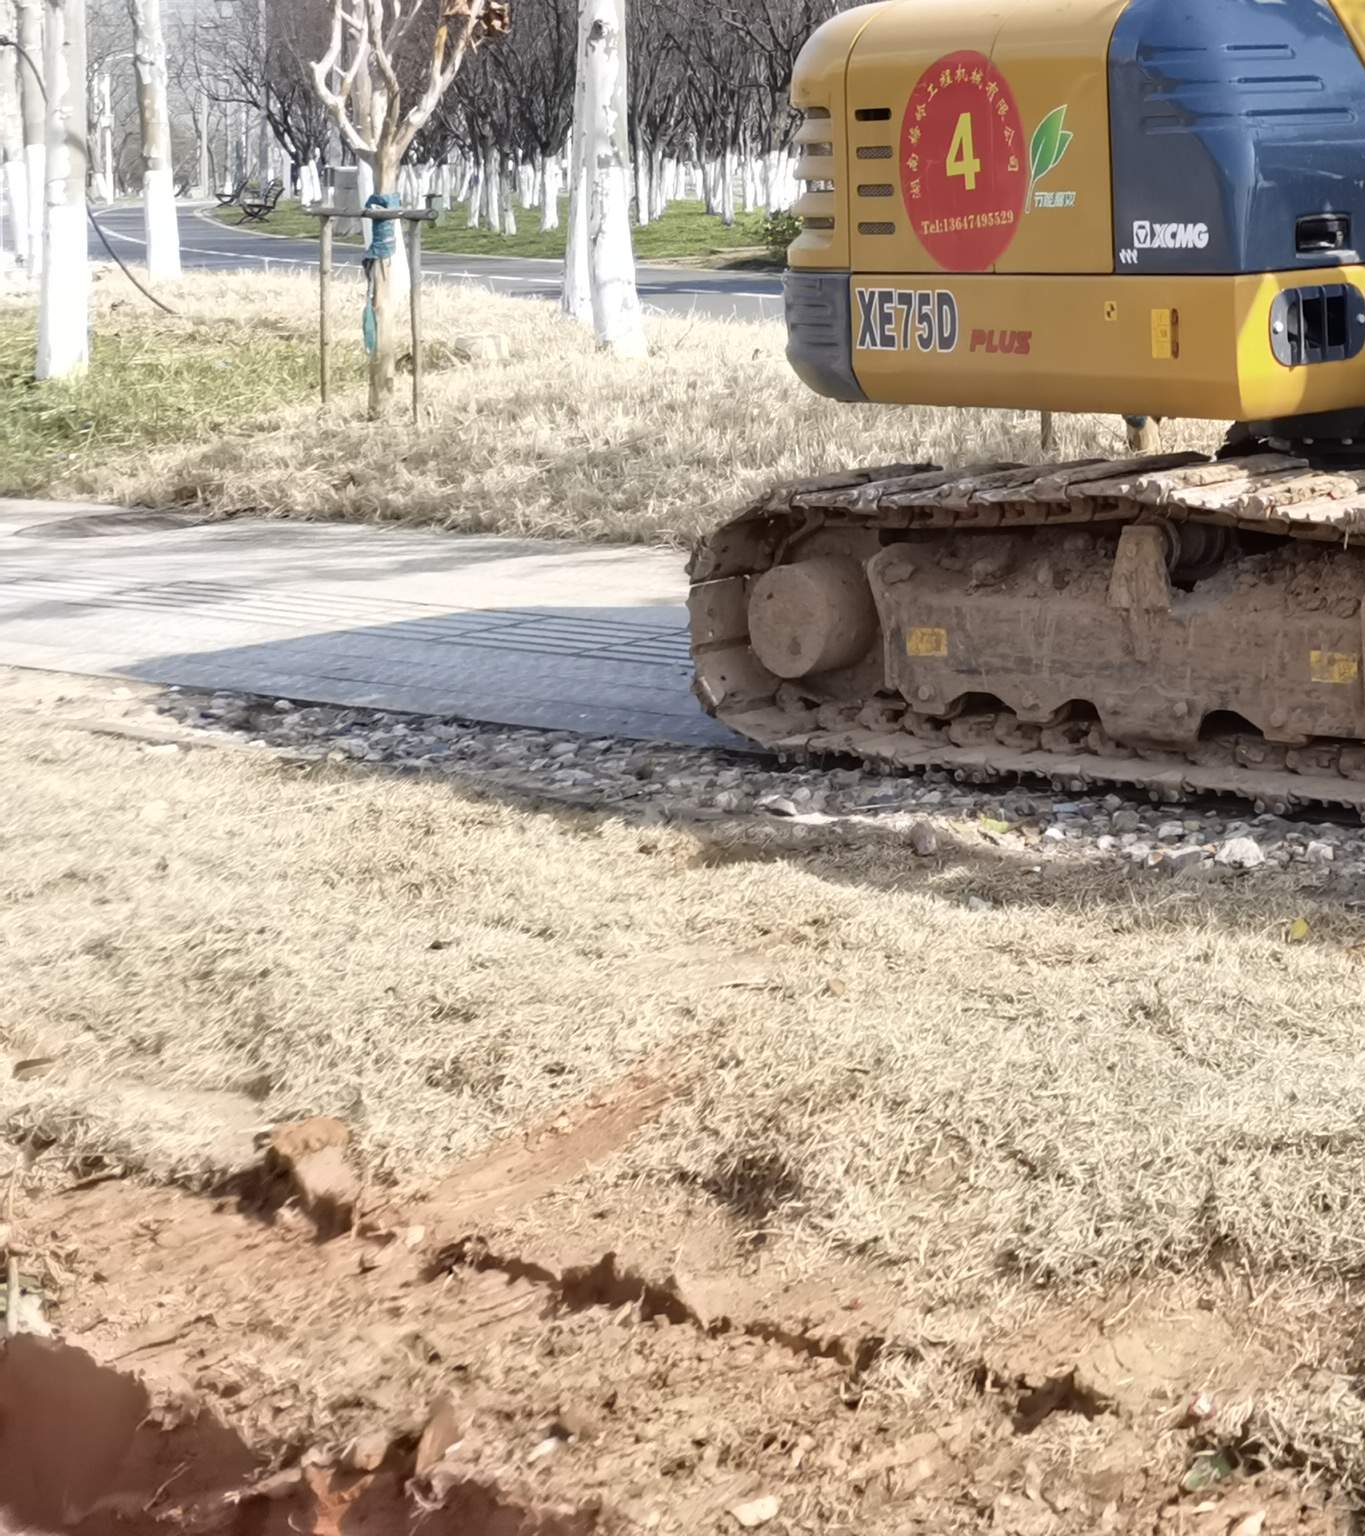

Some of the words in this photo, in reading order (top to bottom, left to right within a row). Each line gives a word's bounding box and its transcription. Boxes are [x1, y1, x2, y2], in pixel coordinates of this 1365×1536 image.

[946, 112, 981, 191] 4
[1150, 222, 1209, 248] XCMG
[855, 287, 959, 353] XE75D
[969, 328, 1032, 355] PLUS
